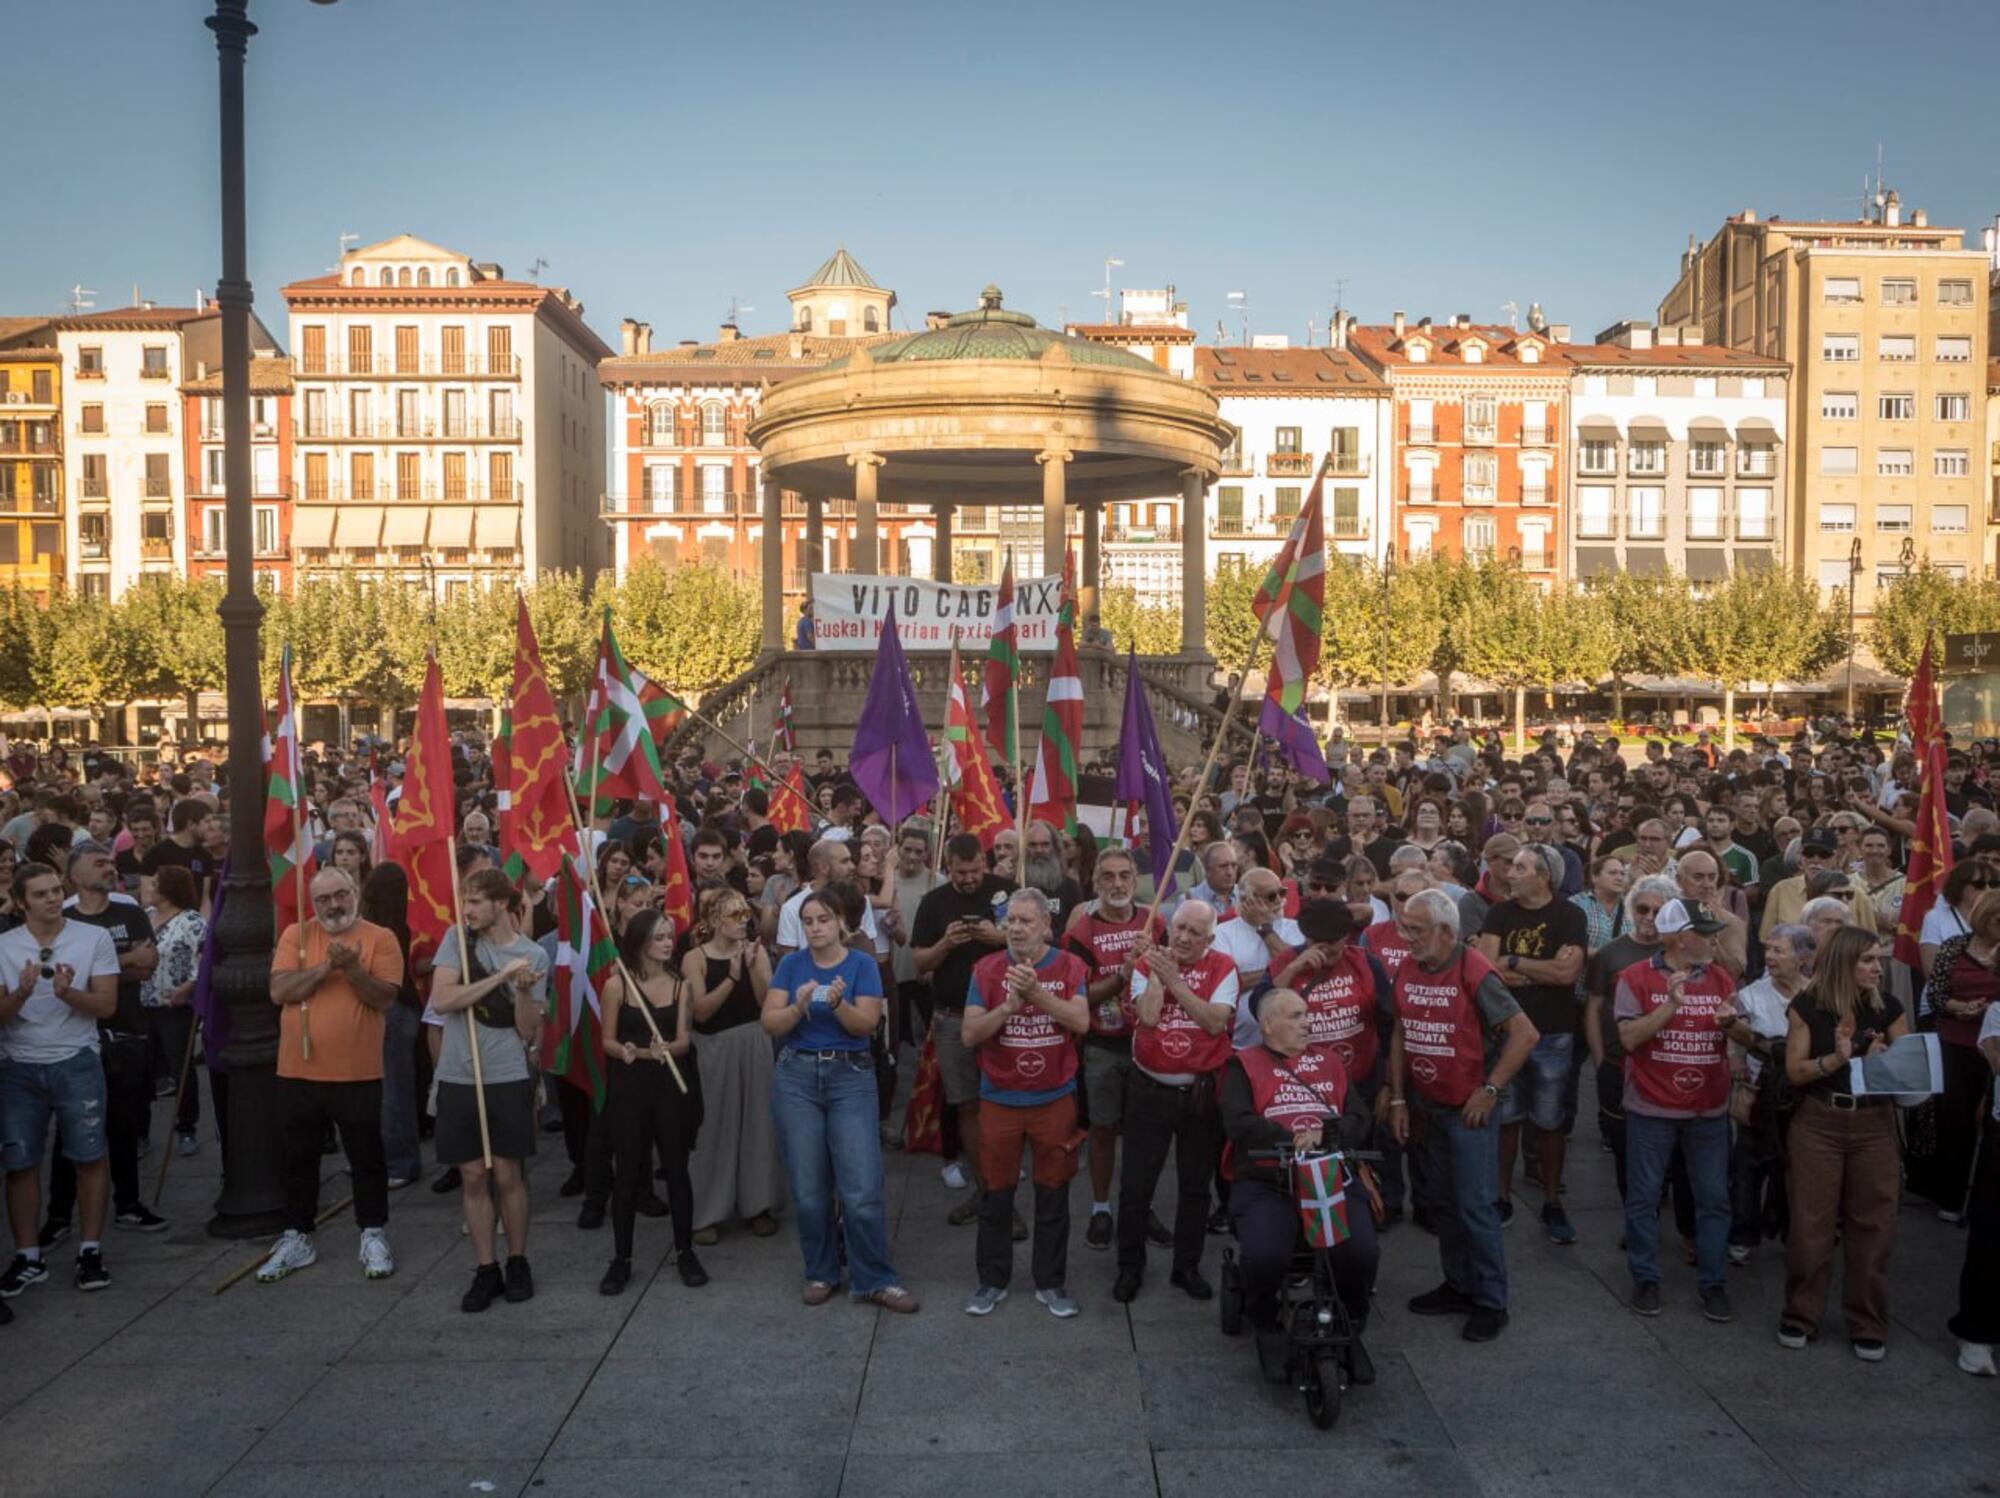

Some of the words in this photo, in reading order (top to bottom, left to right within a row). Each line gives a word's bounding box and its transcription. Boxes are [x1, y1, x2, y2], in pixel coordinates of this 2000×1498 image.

[852, 584, 919, 617] VITO
[815, 619, 865, 638] Euskal
[874, 619, 938, 640] Hrrian
